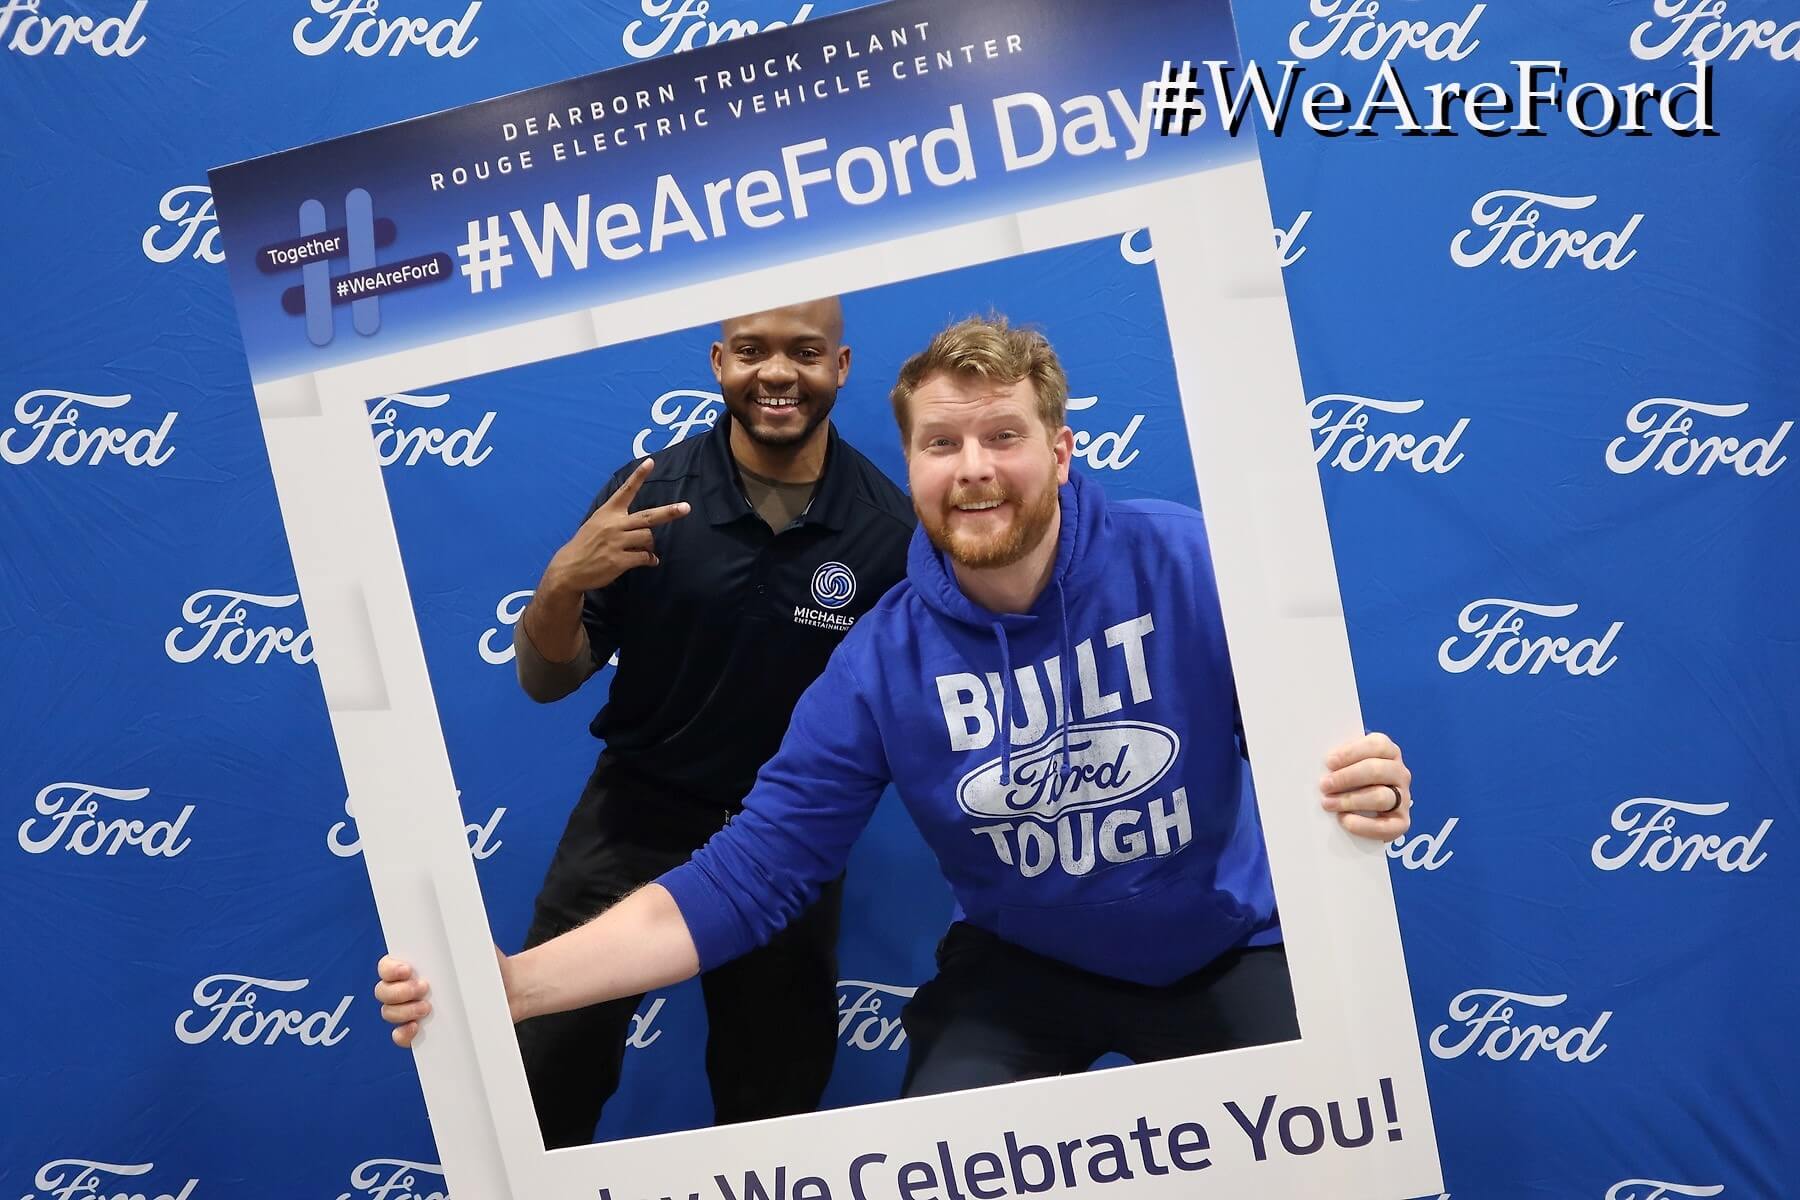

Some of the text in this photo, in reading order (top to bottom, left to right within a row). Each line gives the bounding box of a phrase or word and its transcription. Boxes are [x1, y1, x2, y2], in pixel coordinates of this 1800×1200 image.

[293, 0, 482, 58] Ford
[1289, 0, 1487, 62] Ford
[430, 33, 1023, 191] ROUGE ELECTRIC VEHICLE CENTER
[502, 21, 930, 142] DEARBORN TRUCK PLANT
[456, 103, 977, 296] #WeAreFord
[1450, 189, 1645, 270] Ford
[267, 236, 342, 267] Together
[336, 258, 440, 297] #WeAreFord
[0, 389, 179, 467] Ford
[1606, 397, 1795, 477] Ford
[793, 605, 855, 626] MICHAELS
[1438, 598, 1625, 676] Ford
[936, 613, 1155, 751] BUILT
[17, 782, 196, 857] Ford
[970, 786, 1193, 878] TOUGH
[1592, 797, 1774, 873] Ford
[174, 973, 355, 1047] Ford
[1430, 988, 1613, 1063] Ford
[849, 1116, 1213, 1200] Celebrate
[1222, 1077, 1404, 1162] You!
